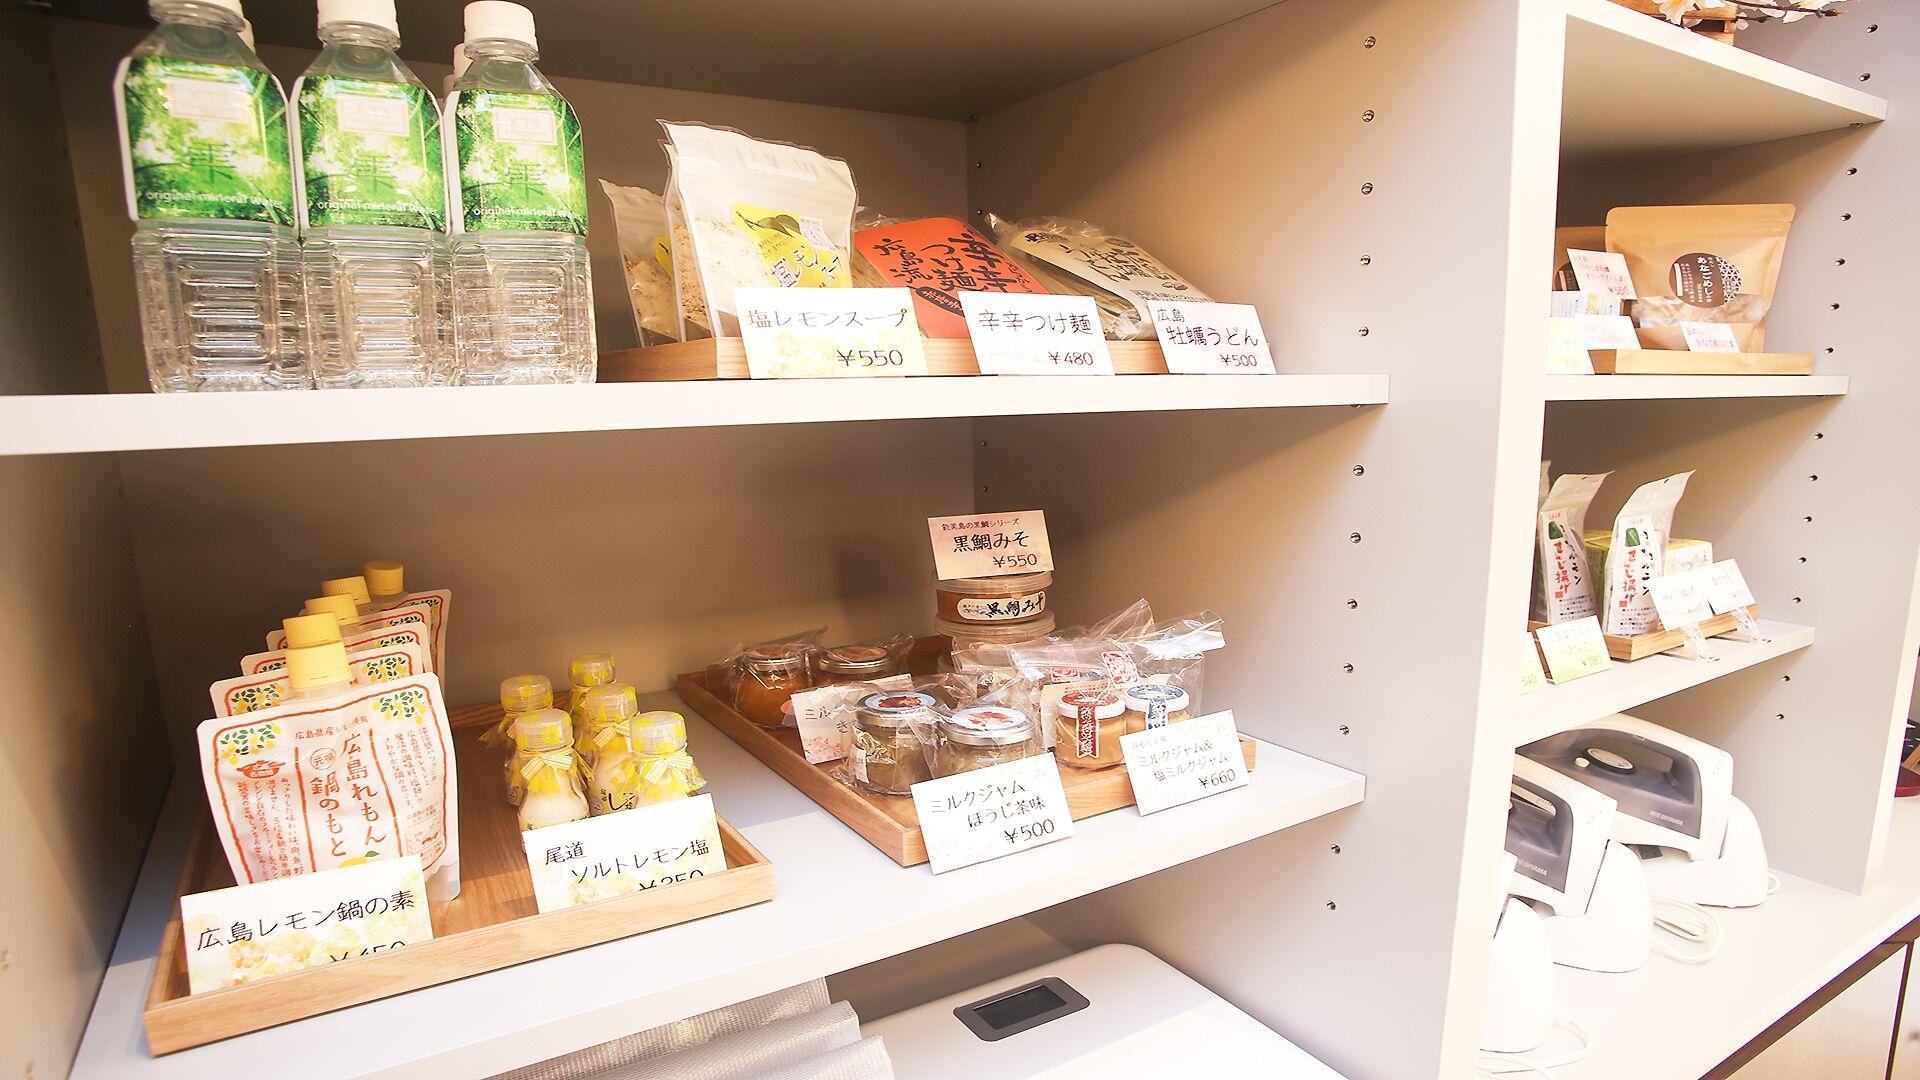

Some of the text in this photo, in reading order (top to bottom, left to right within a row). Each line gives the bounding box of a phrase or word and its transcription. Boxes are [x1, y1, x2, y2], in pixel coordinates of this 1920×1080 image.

[147, 189, 193, 203] original
[318, 201, 359, 212] original
[474, 206, 513, 219] original
[516, 208, 556, 217] mineral
[747, 309, 908, 328] 塩レモンスープ
[978, 309, 1093, 335] 辛辛つけ麺
[1157, 308, 1185, 323] 広島
[1166, 326, 1259, 347] 牡蠣うどん
[836, 349, 904, 367] ¥550
[1048, 351, 1094, 366] ¥480
[1220, 353, 1258, 368] ¥500
[953, 530, 1030, 553] 黒鯛みそ
[992, 553, 1038, 568] ¥550
[805, 705, 835, 719] ミル
[1139, 739, 1214, 767] ミルクジャム&
[1153, 753, 1229, 782] 塩ミルクジャム
[1198, 768, 1237, 789] ¥660
[340, 733, 387, 846] 広島れもん
[930, 780, 1026, 812] ミルクジャム
[309, 770, 346, 857] 鍋のもと
[967, 795, 1046, 828] ほうじ茶味
[1004, 818, 1055, 844] ¥500
[545, 841, 587, 866] 尾道
[571, 838, 710, 884] ソルトレモン塩
[197, 890, 415, 951] 広島レモン鍋の素
